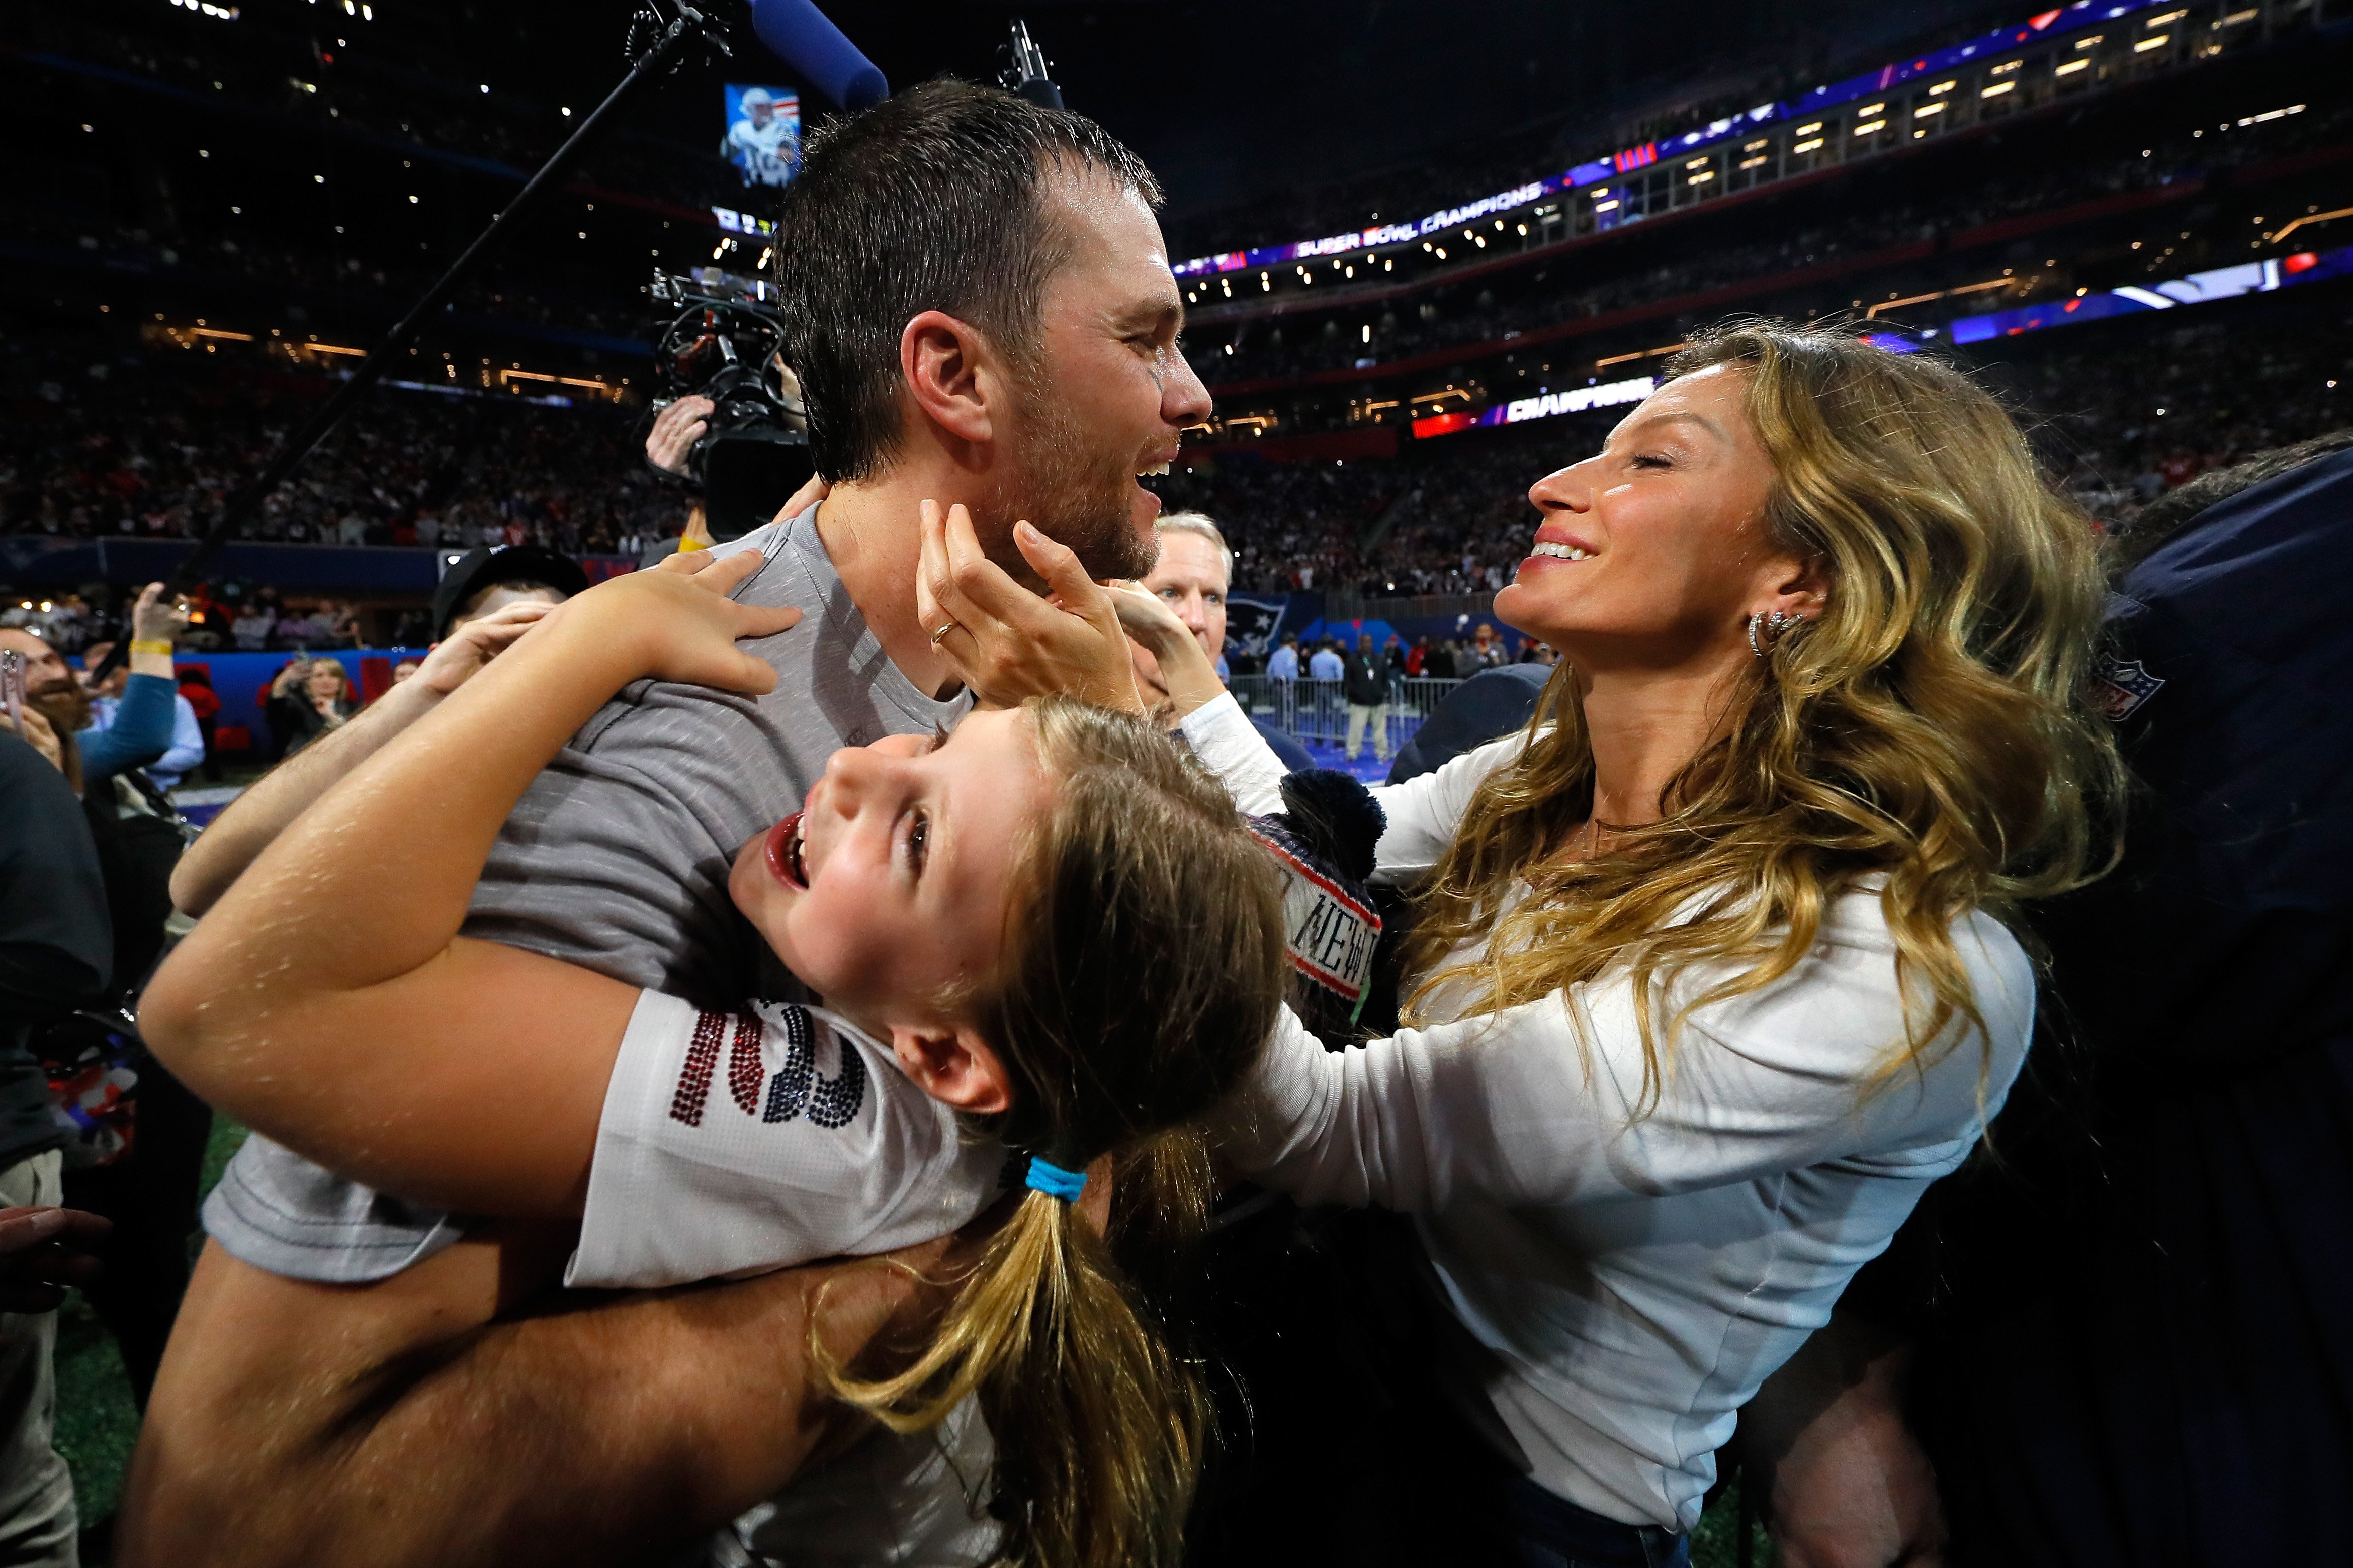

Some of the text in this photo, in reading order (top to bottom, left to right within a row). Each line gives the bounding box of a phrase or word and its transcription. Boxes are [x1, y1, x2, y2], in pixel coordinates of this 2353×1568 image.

[1297, 181, 1544, 258] SUPER BOWL CHAMPIONS
[1294, 893, 1368, 983] NEW
